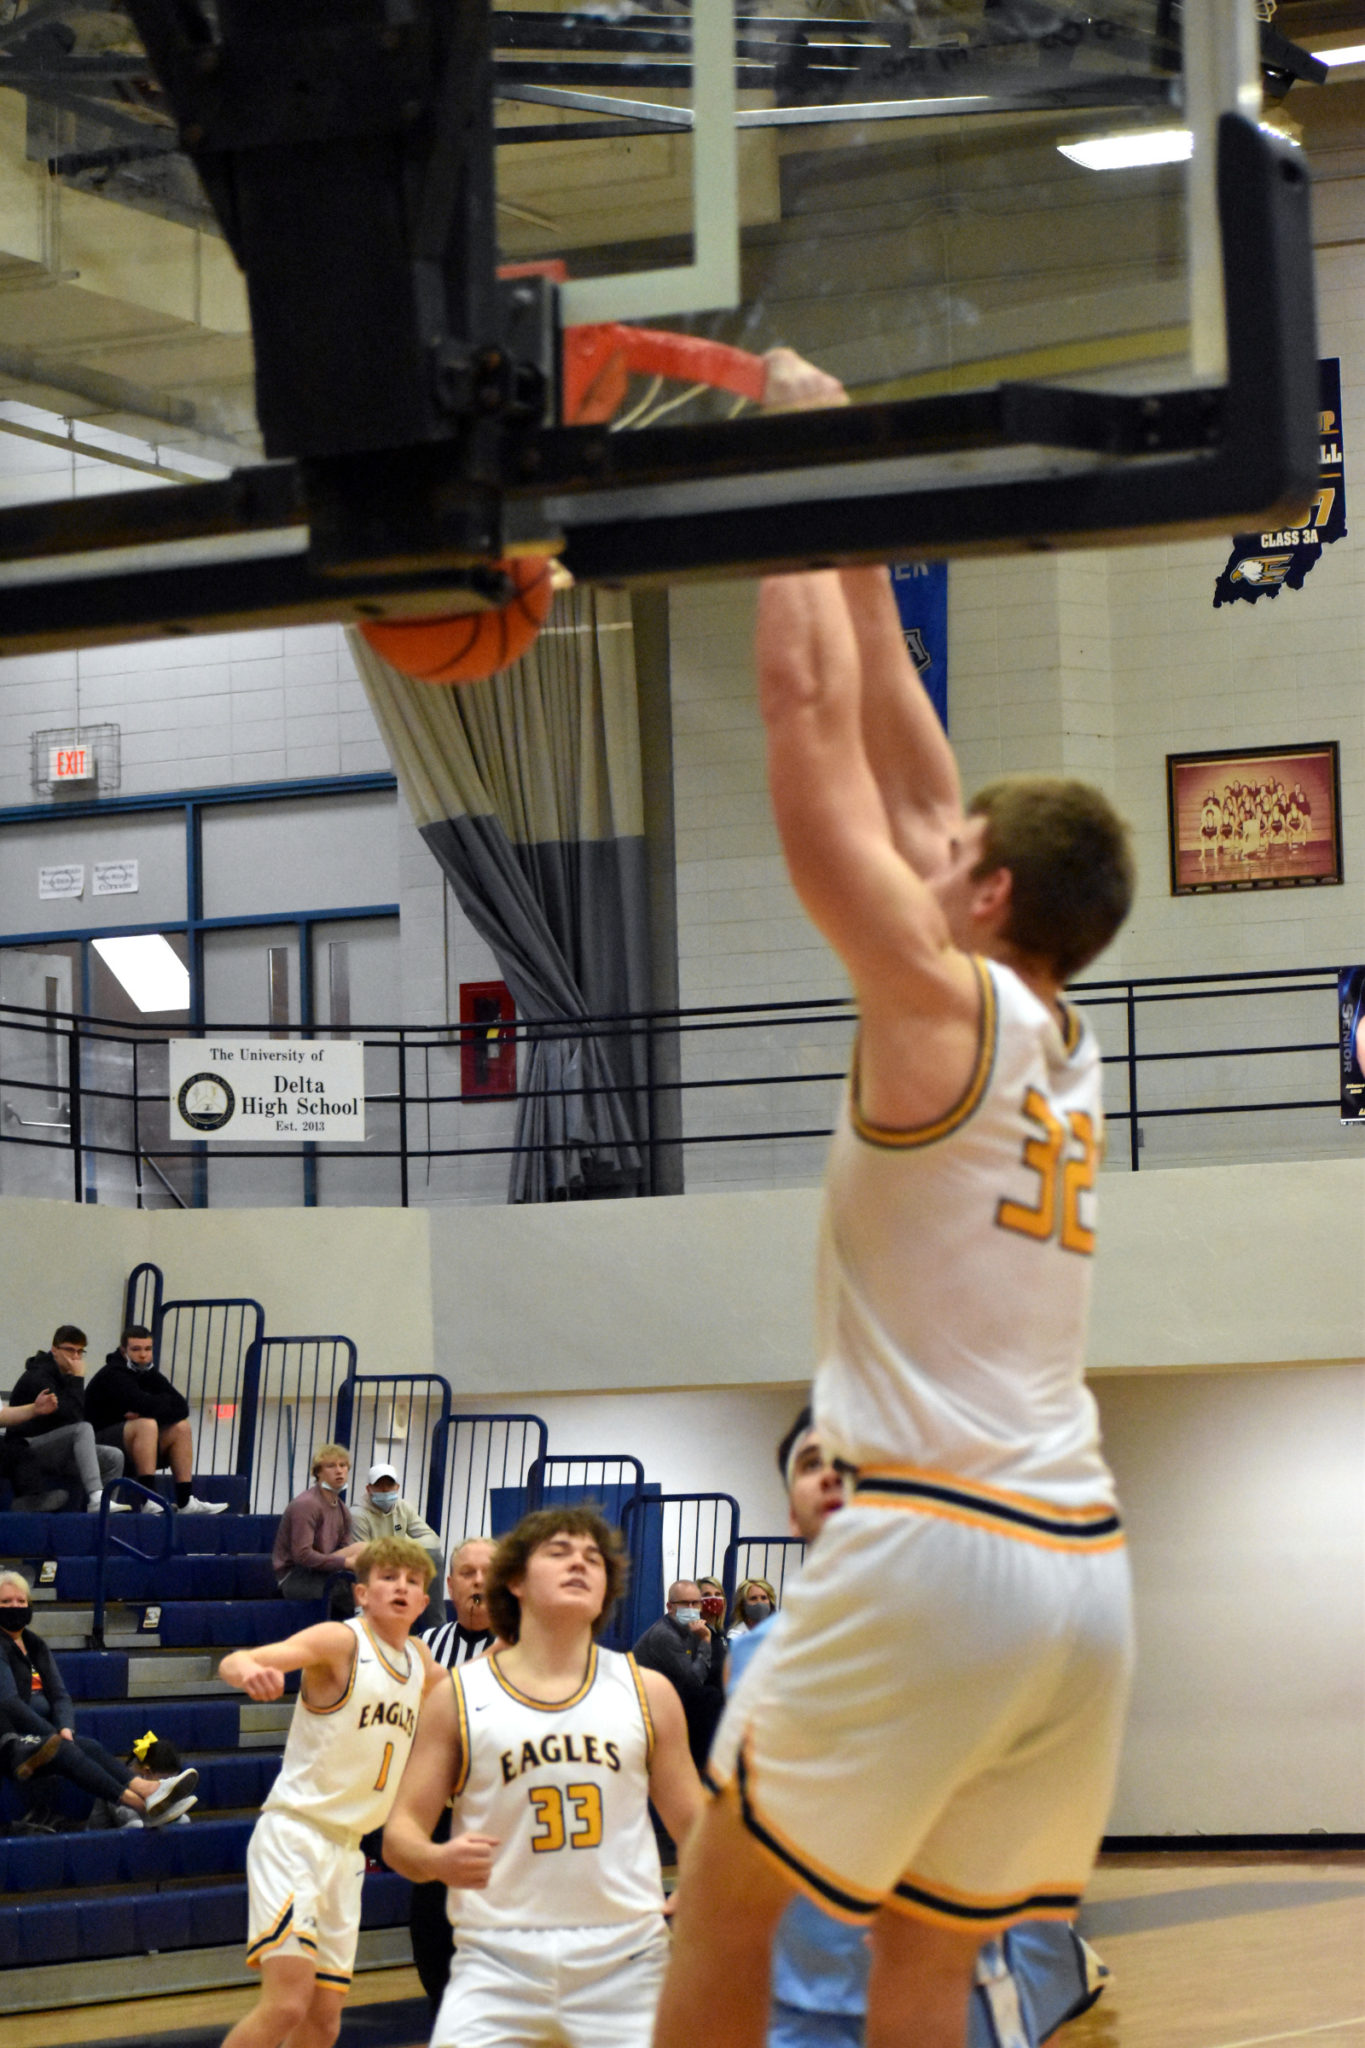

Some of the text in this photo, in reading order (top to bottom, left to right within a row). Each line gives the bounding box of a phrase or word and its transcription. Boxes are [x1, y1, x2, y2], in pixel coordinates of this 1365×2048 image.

[1261, 529, 1319, 548] CLASS 3A
[56, 751, 85, 776] EXIT
[1342, 1003, 1354, 1073] SENIOR
[210, 1048, 325, 1063] The University of
[274, 1075, 325, 1093] Delta
[241, 1096, 359, 1118] High School
[276, 1121, 325, 1131] Est. 2013
[994, 1084, 1095, 1256] 32
[373, 1741, 394, 1792] 1
[500, 1734, 621, 1785] EAGLES
[528, 1782, 603, 1854] 33
